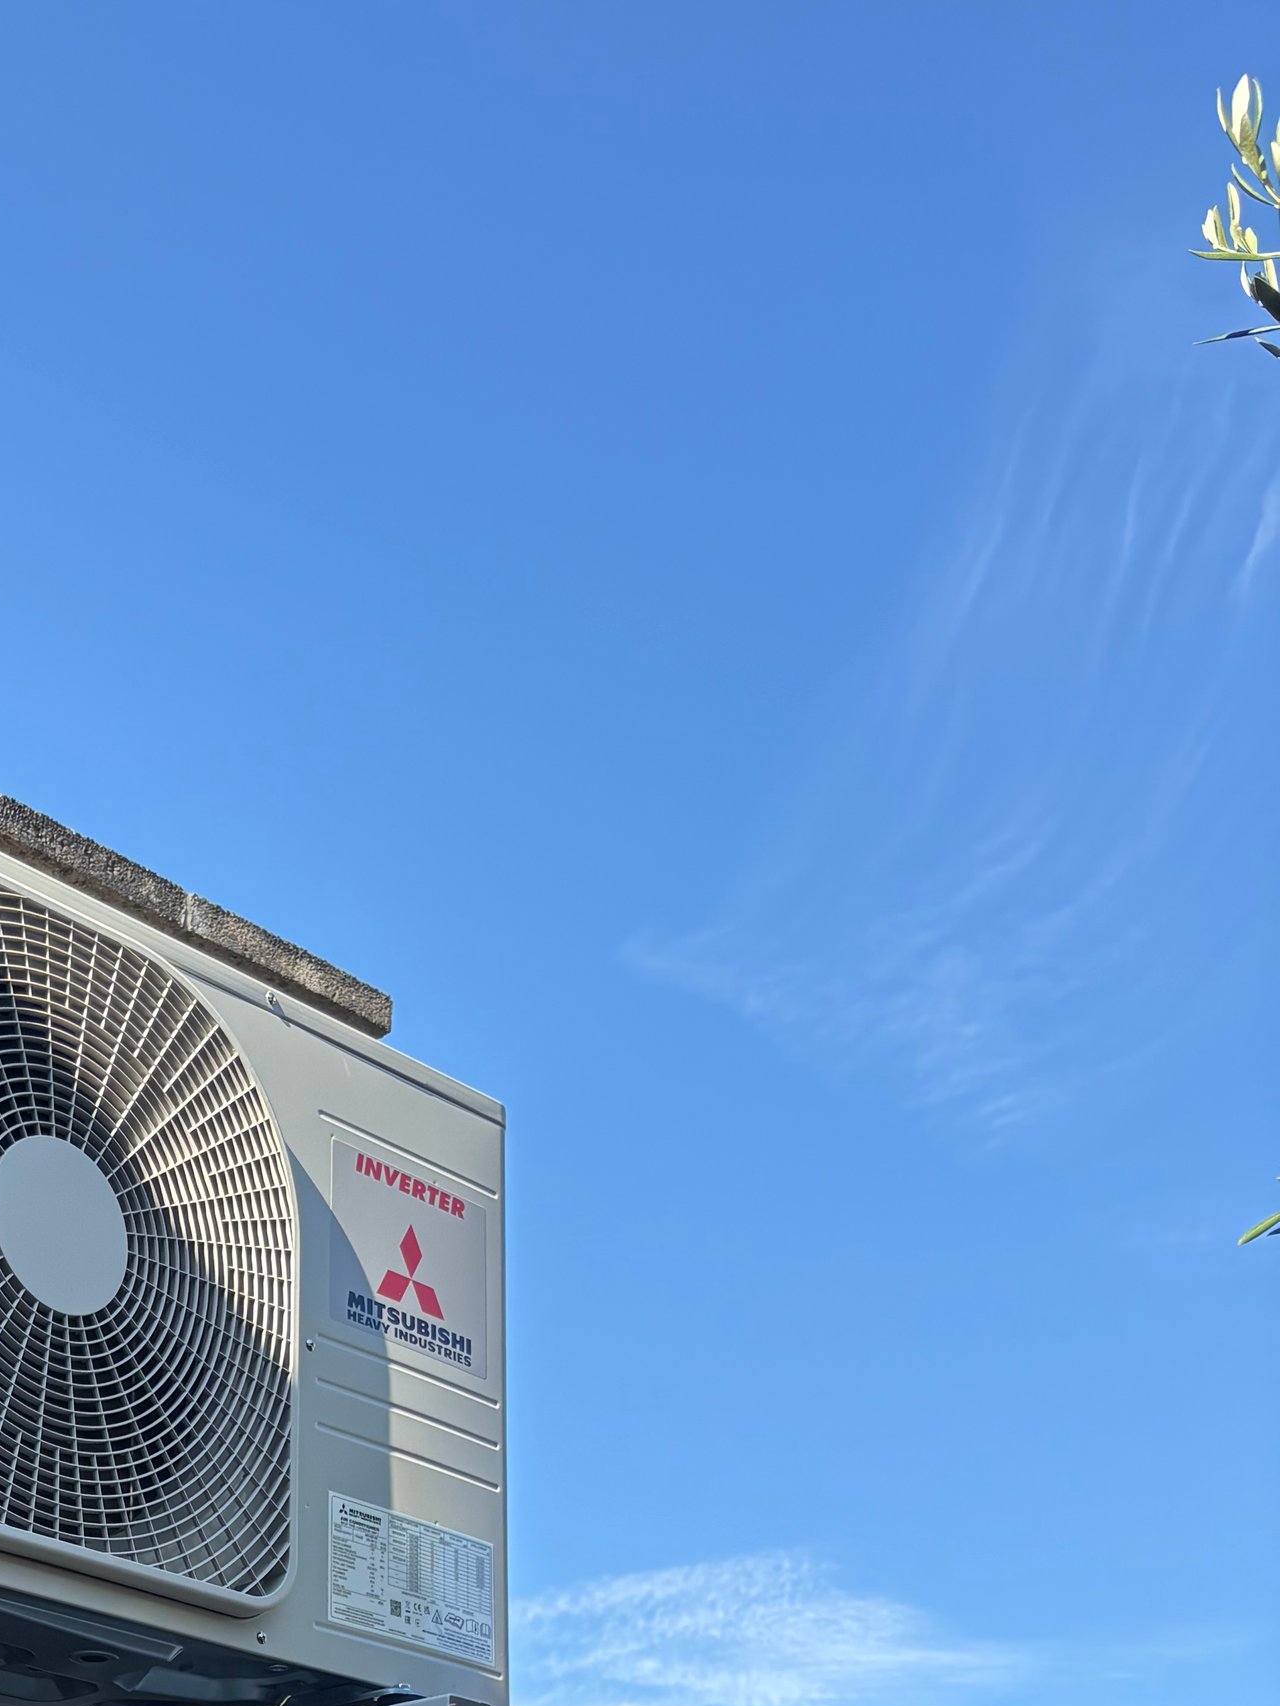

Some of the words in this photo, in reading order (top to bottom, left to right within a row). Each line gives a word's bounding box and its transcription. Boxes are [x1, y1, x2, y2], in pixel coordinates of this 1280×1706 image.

[355, 1153, 465, 1219] INVERTER
[347, 1291, 472, 1355] MITSUBISHI
[347, 1309, 390, 1334] HEAVY
[394, 1328, 472, 1367] INDUSTRIES
